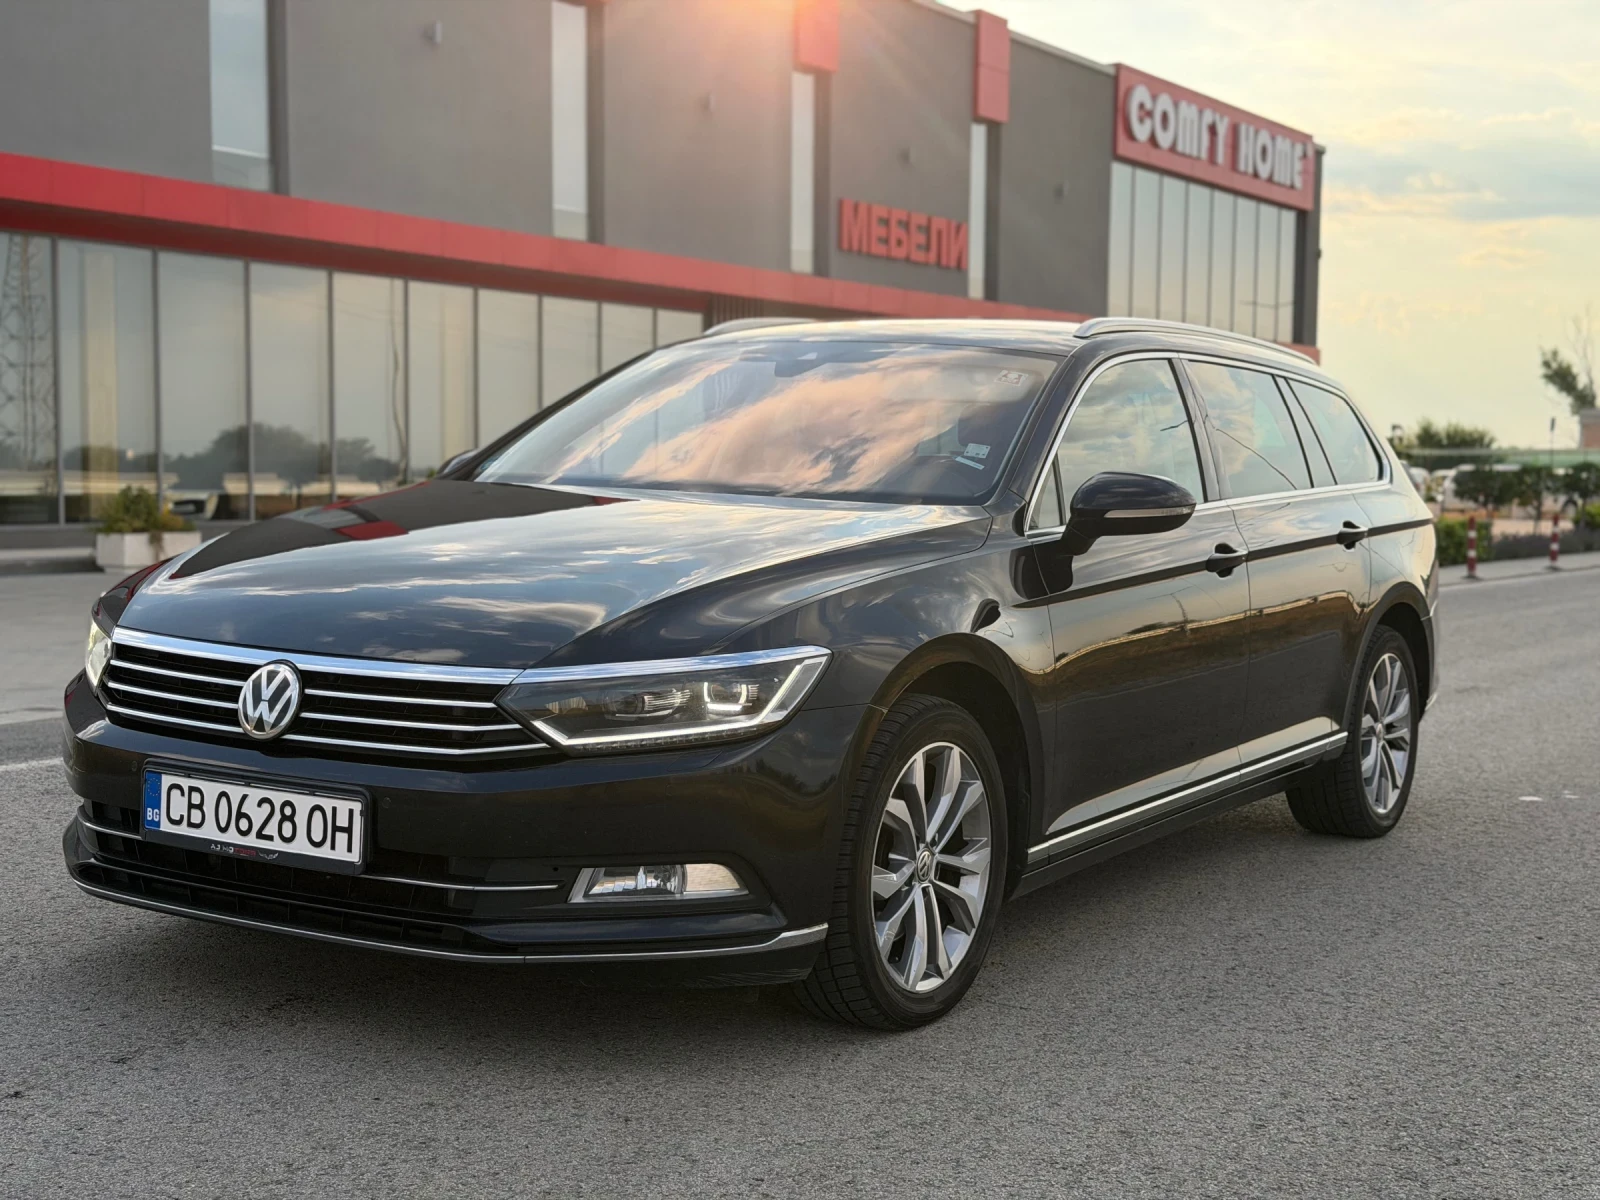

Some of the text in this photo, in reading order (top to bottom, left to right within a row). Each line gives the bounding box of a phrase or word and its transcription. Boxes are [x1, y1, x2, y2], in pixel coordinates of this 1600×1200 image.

[1129, 84, 1304, 191] COMFY HOME
[839, 197, 968, 271] МЕБЕЛИ
[147, 807, 160, 822] BG
[166, 783, 354, 853] CB 0628 OH
